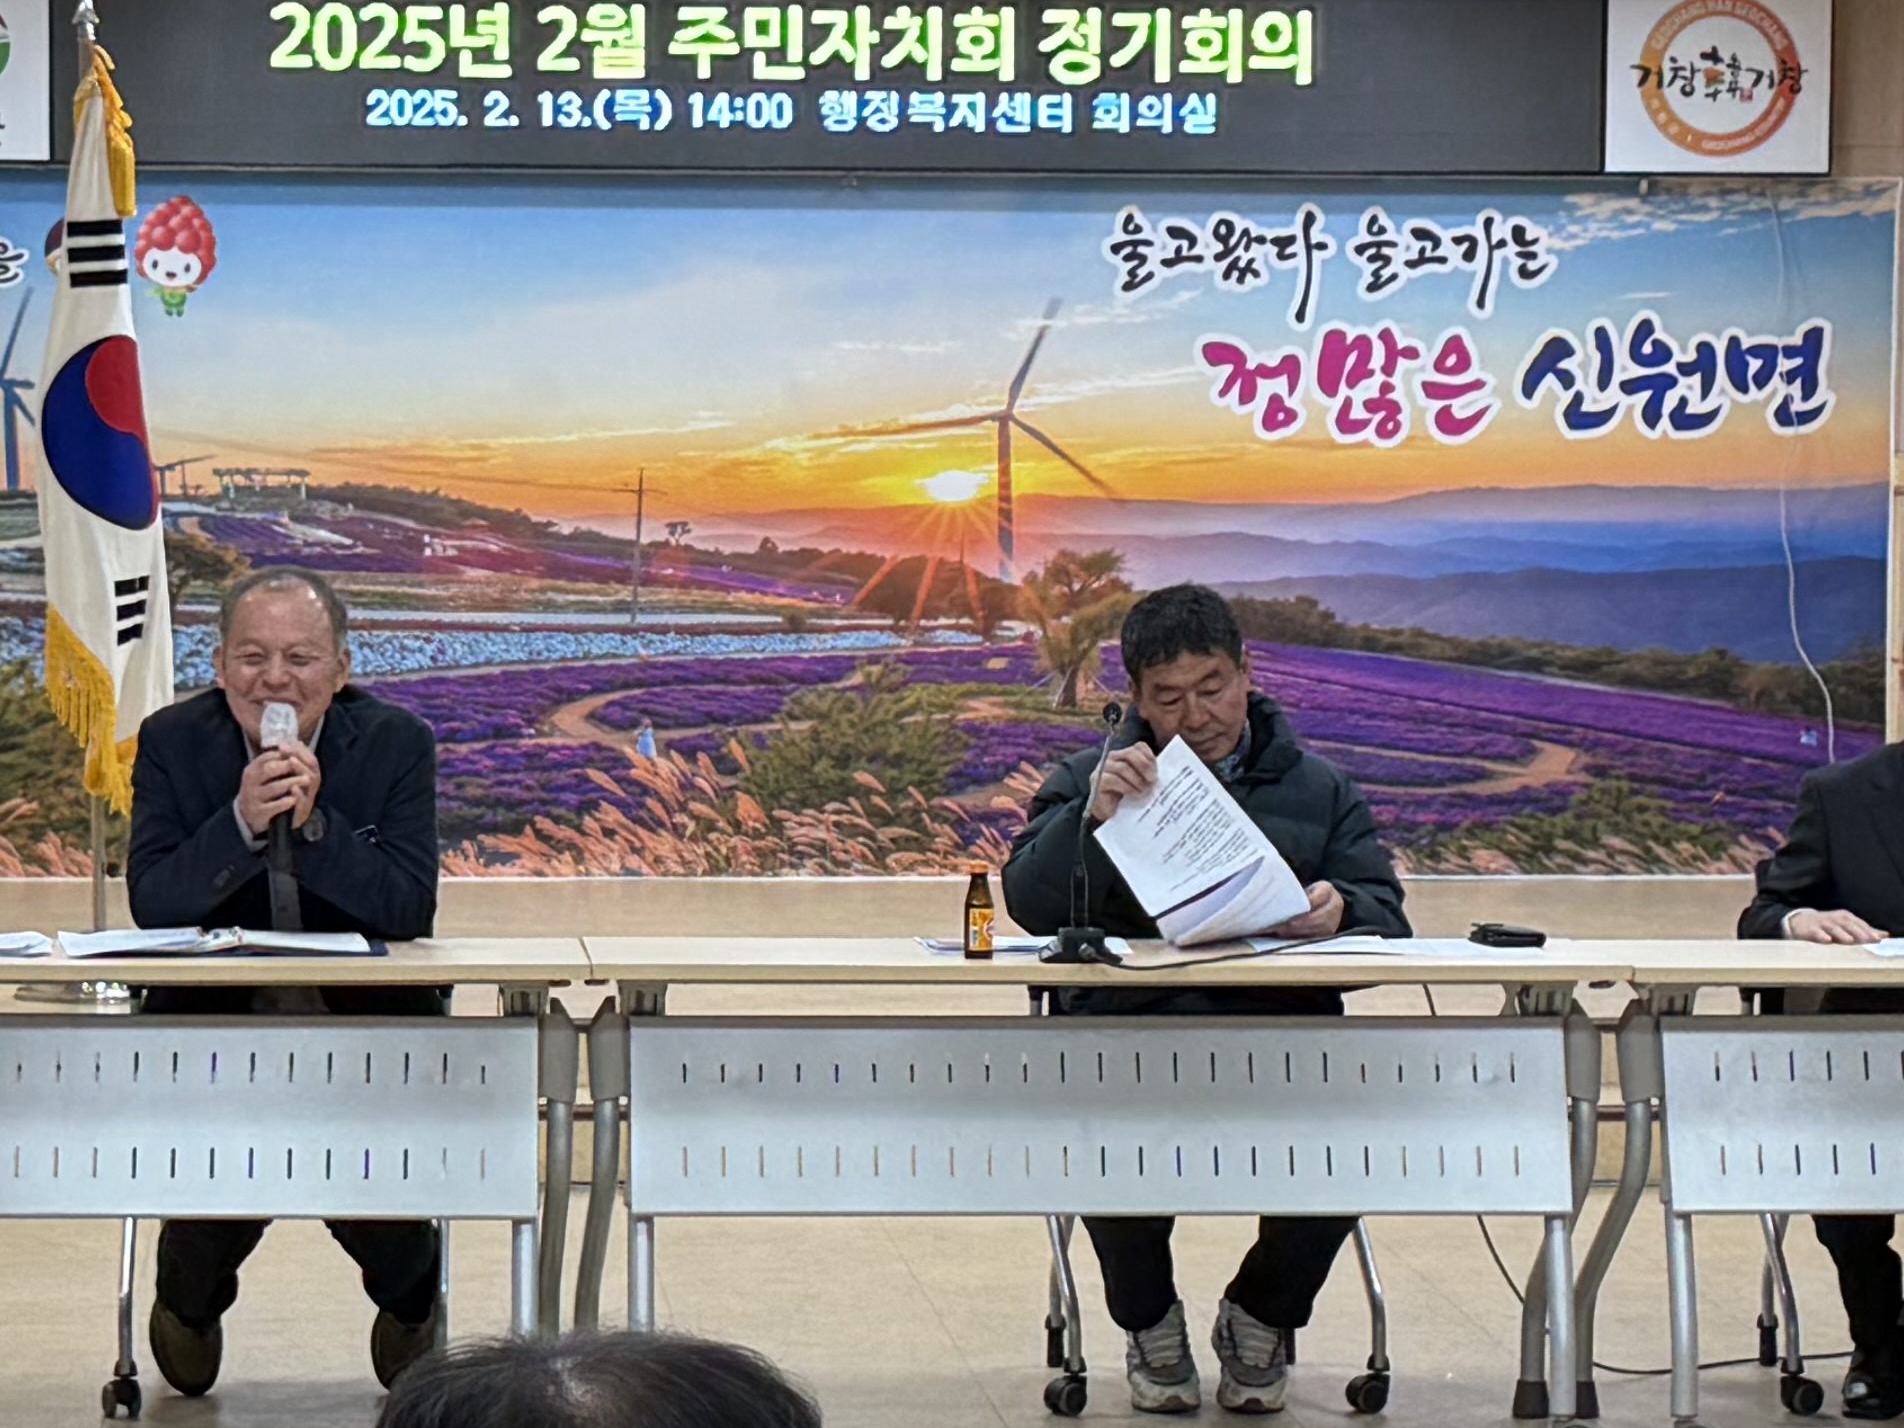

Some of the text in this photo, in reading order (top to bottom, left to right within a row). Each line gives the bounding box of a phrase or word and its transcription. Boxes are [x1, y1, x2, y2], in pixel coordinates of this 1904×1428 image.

[270, 2, 1312, 85] 2025년 2월 주민자치회 정기회의
[366, 89, 1217, 134] 2025. 2. 13.(목) 14:00 행정복지센터 회의실
[1521, 318, 1830, 432] 신원면
